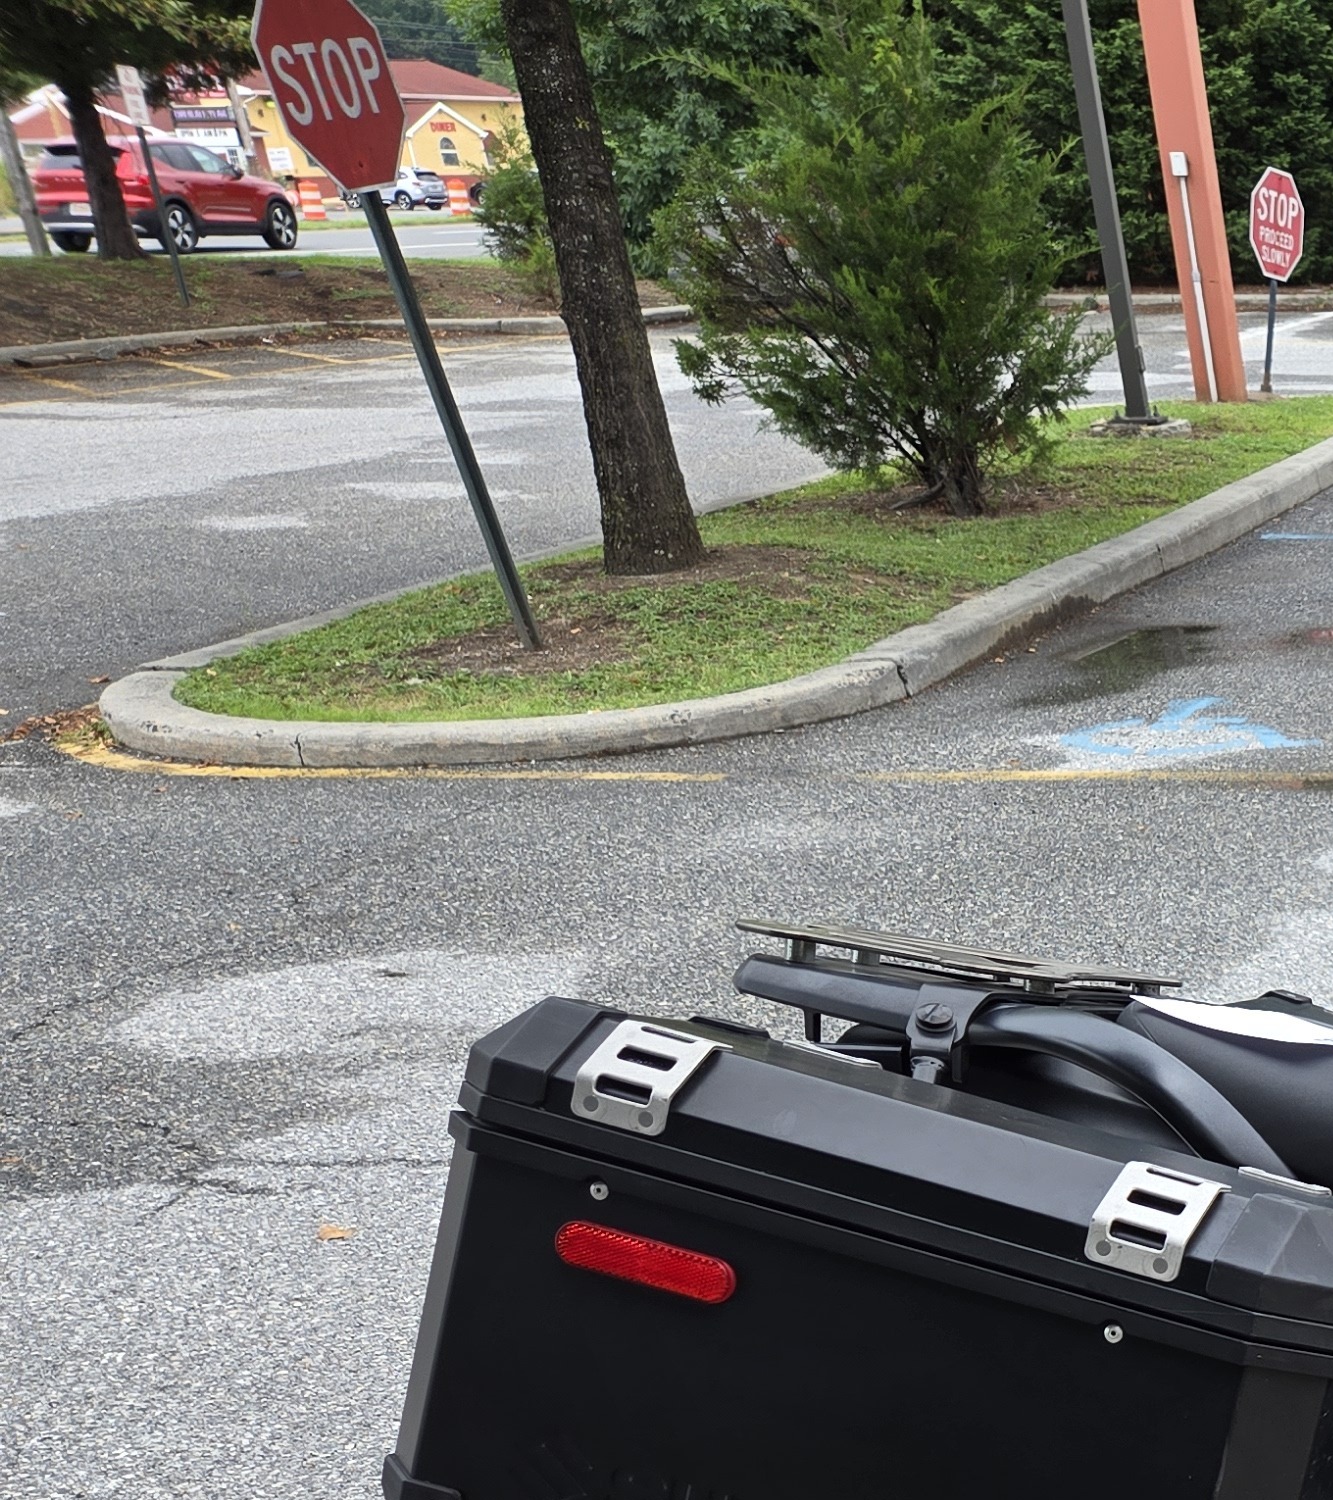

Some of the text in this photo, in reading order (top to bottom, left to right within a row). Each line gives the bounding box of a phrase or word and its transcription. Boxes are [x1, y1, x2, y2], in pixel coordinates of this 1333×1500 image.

[271, 37, 380, 126] STOP
[429, 122, 457, 132] DINER
[1257, 187, 1299, 230] STOP
[1260, 225, 1295, 251] PROCEED
[1261, 245, 1291, 268] SLOWLY
